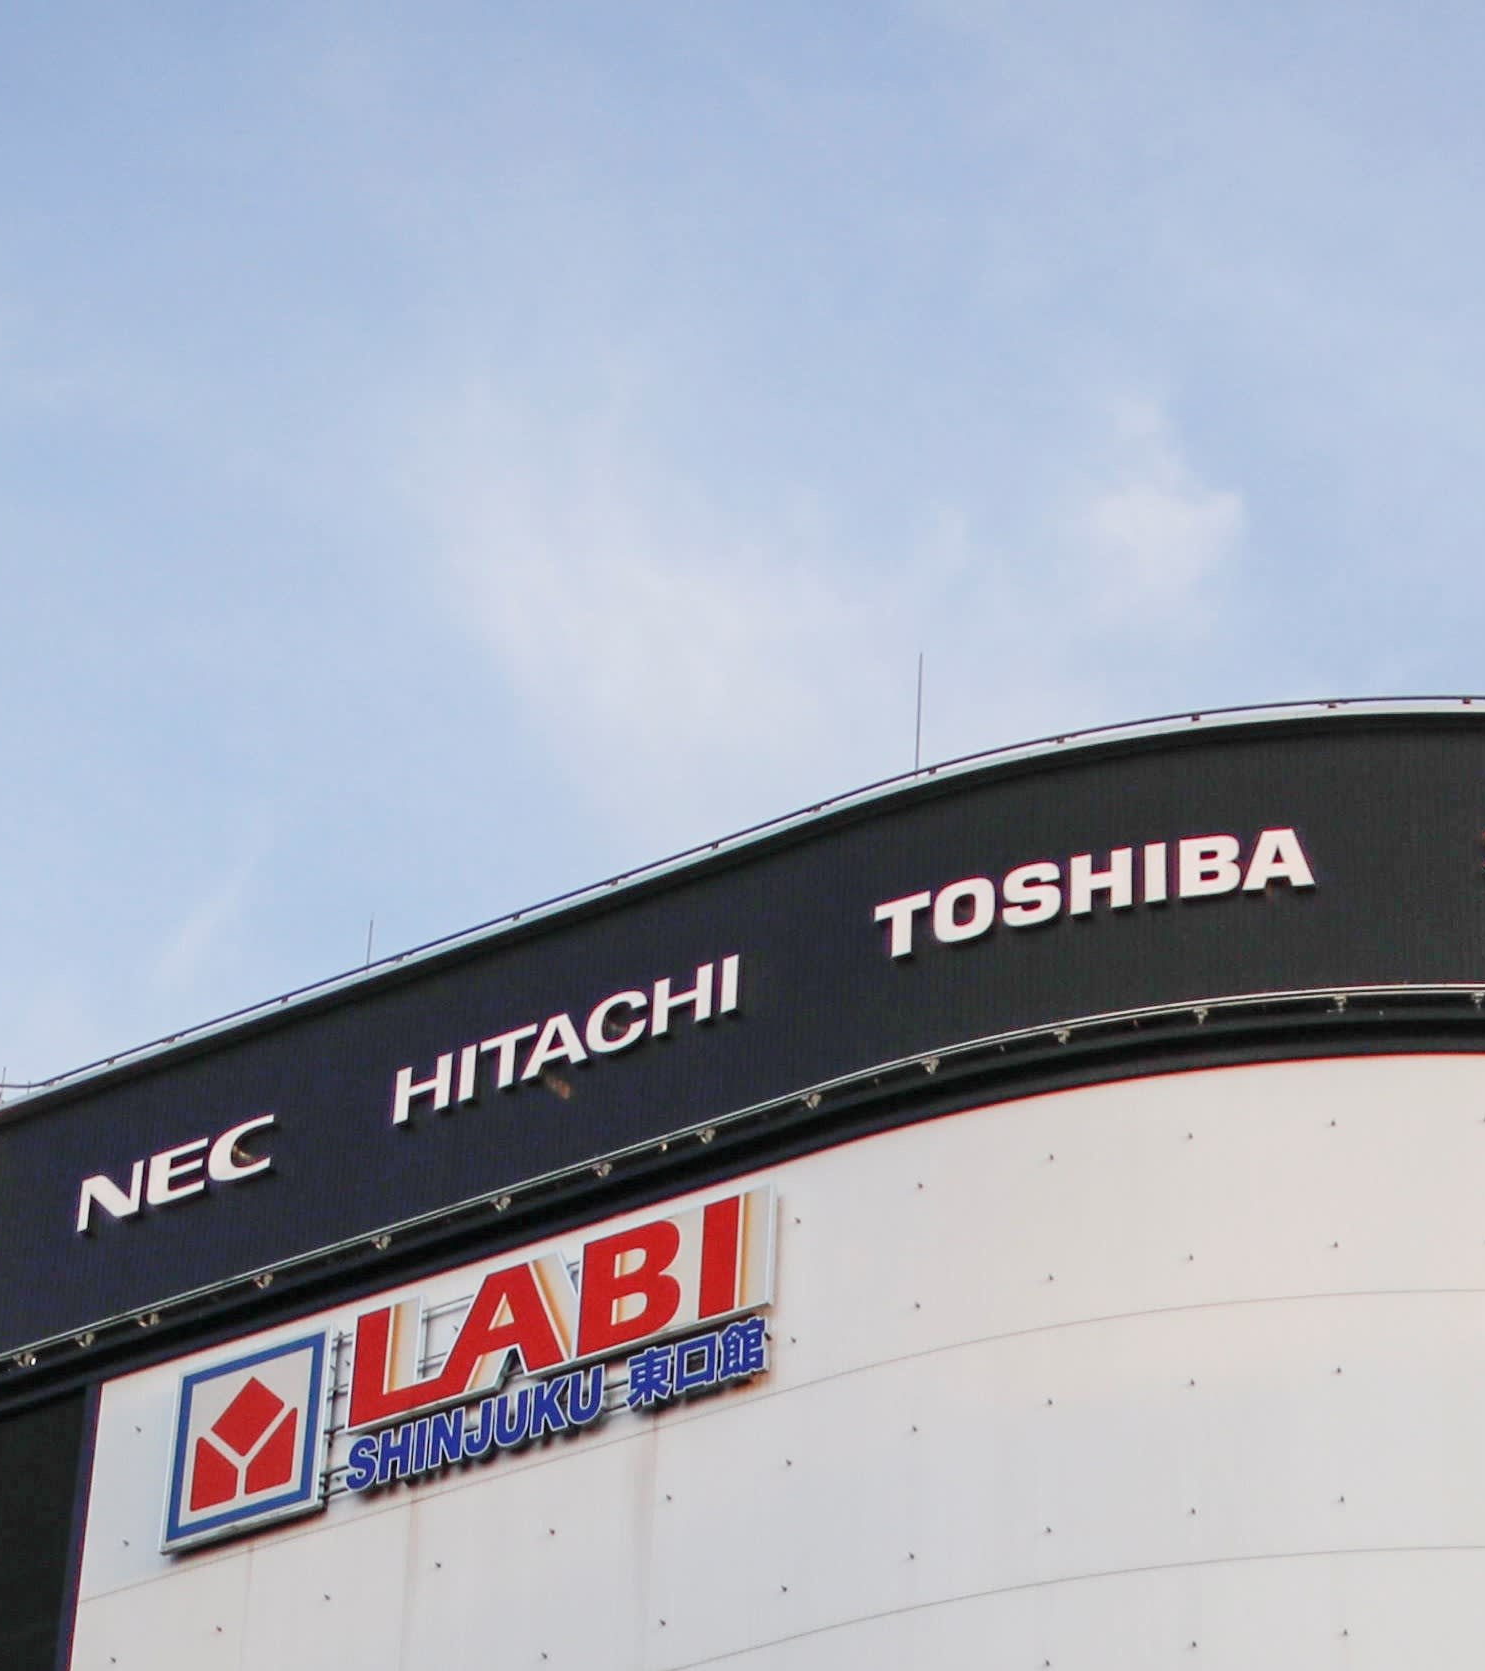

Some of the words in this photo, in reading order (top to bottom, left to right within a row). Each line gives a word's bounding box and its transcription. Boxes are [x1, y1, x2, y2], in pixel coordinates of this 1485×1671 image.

[875, 829, 1315, 958] TOSHIBA
[391, 954, 742, 1127] HITACHI
[75, 1113, 276, 1235] NEC
[346, 1190, 754, 1432] LABI
[345, 1364, 604, 1494] SHINJUKU
[626, 1316, 769, 1409] 東口館
